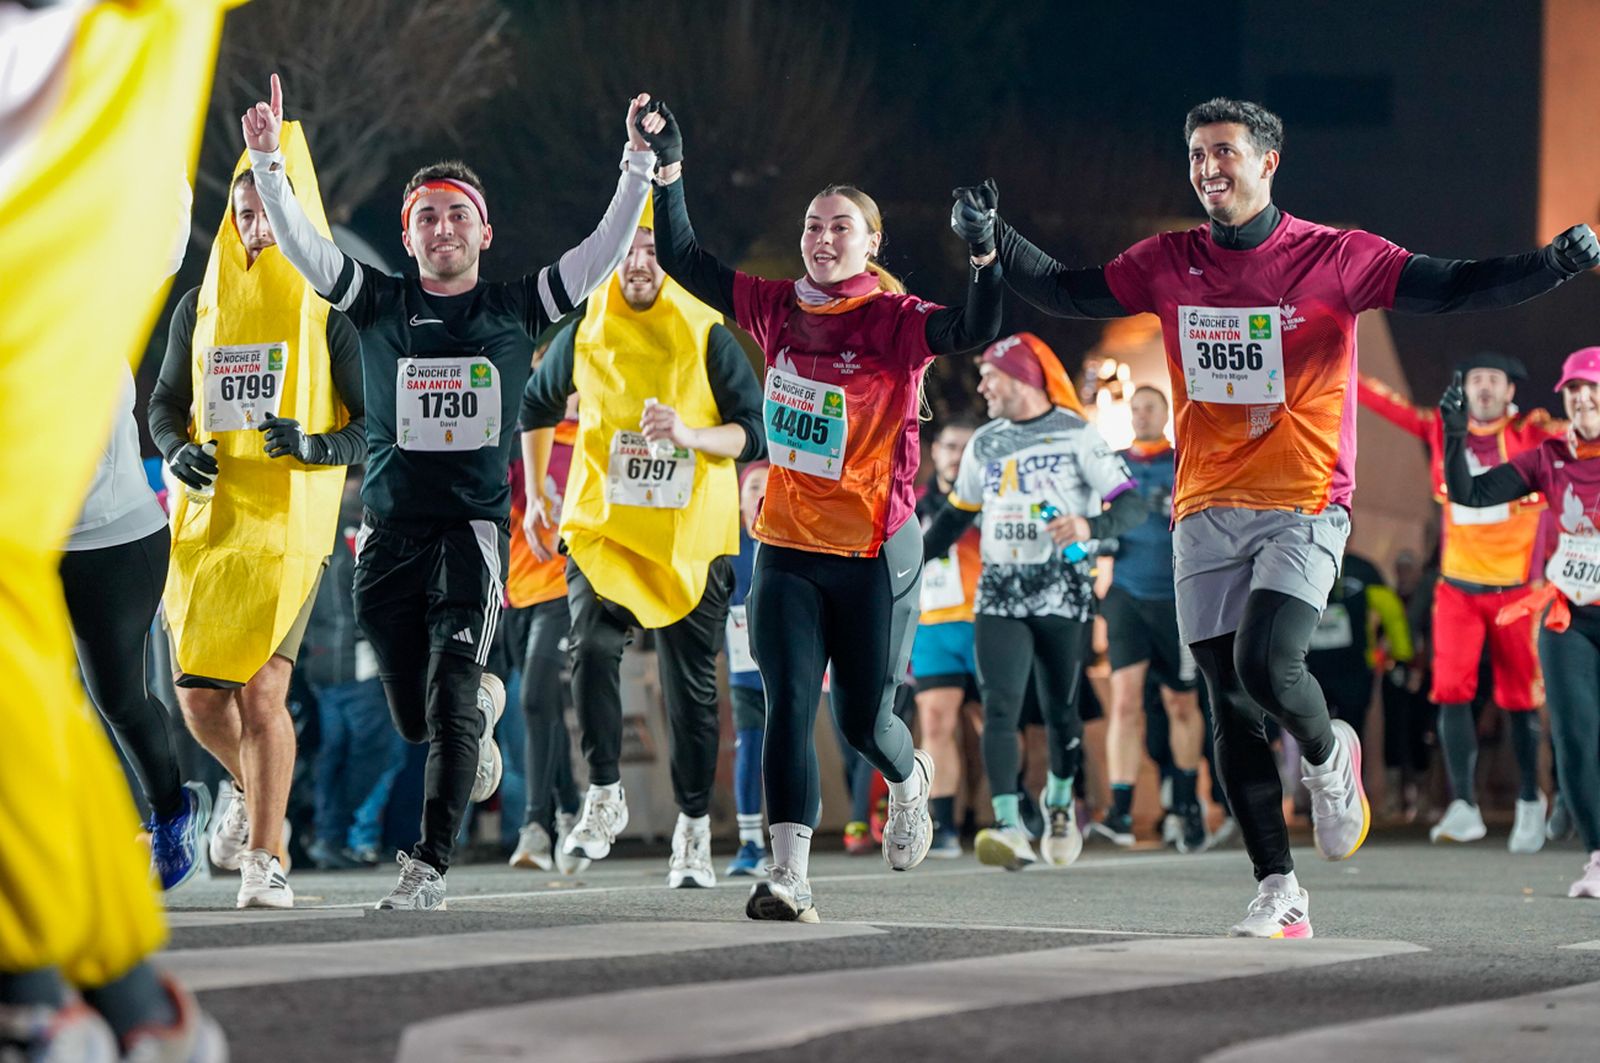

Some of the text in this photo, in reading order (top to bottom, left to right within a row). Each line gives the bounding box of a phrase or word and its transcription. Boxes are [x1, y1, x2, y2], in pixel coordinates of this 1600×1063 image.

[1199, 318, 1226, 328] NOCHE
[1228, 319, 1240, 328] DE
[1189, 329, 1207, 340] SAN
[1209, 328, 1241, 341] ANTÓN
[223, 354, 249, 363] NOCHE
[250, 353, 261, 362] DE
[1196, 341, 1263, 371] 3656
[213, 365, 231, 375] SAN
[232, 363, 261, 374] ANTÓN
[417, 368, 448, 378] NOCHE
[449, 368, 462, 378] DE
[221, 373, 276, 401] 6799
[406, 380, 427, 390] SAN
[428, 378, 463, 390] ANTÓN
[781, 383, 805, 398] NOCHE
[804, 390, 817, 401] DE
[418, 391, 478, 419] 1730
[771, 390, 787, 403] SAN
[786, 398, 815, 412] ANTÓN
[770, 406, 830, 445] 4405
[627, 457, 677, 482] 6797
[994, 522, 1038, 540] 6388
